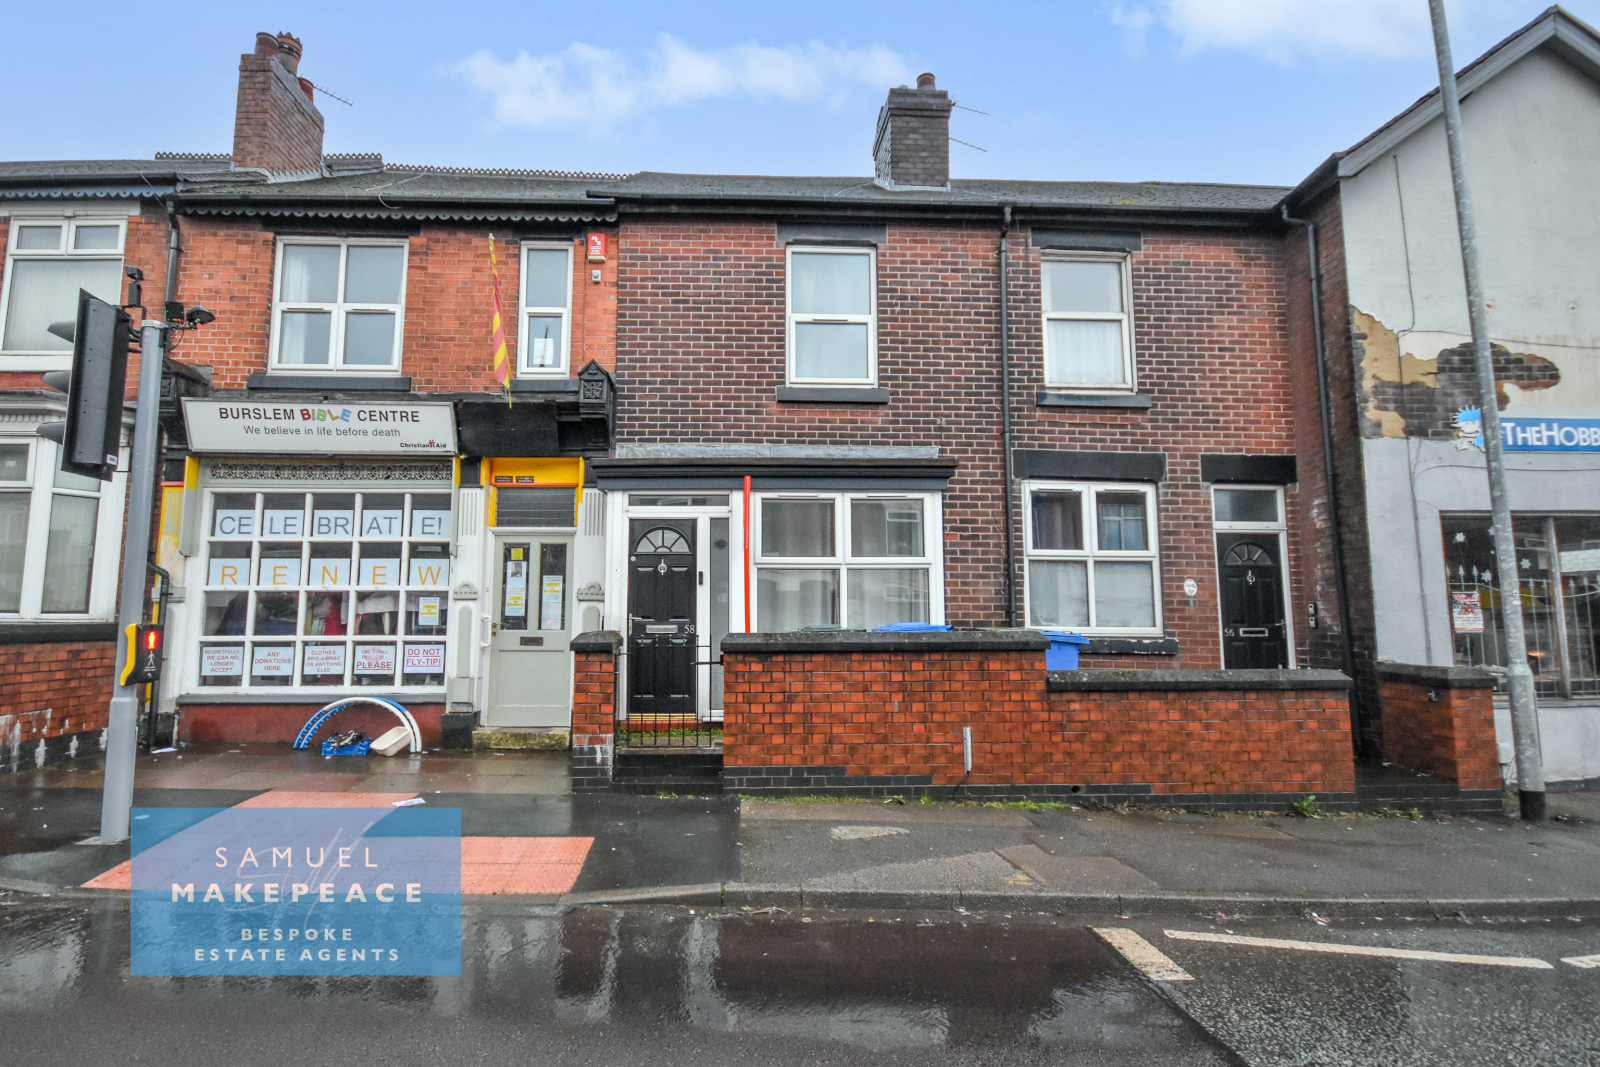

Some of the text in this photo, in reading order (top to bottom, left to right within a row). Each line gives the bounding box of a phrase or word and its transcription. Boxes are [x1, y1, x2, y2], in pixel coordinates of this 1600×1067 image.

[219, 407, 420, 422] BURSLEM BIBLE CENTRE
[244, 425, 401, 437] We believe in life before death
[684, 624, 695, 634] 58
[1224, 628, 1235, 637] 56
[407, 648, 441, 656] DO NOT
[356, 661, 392, 669] PLEASE
[405, 658, 441, 666] FLY-TIP!
